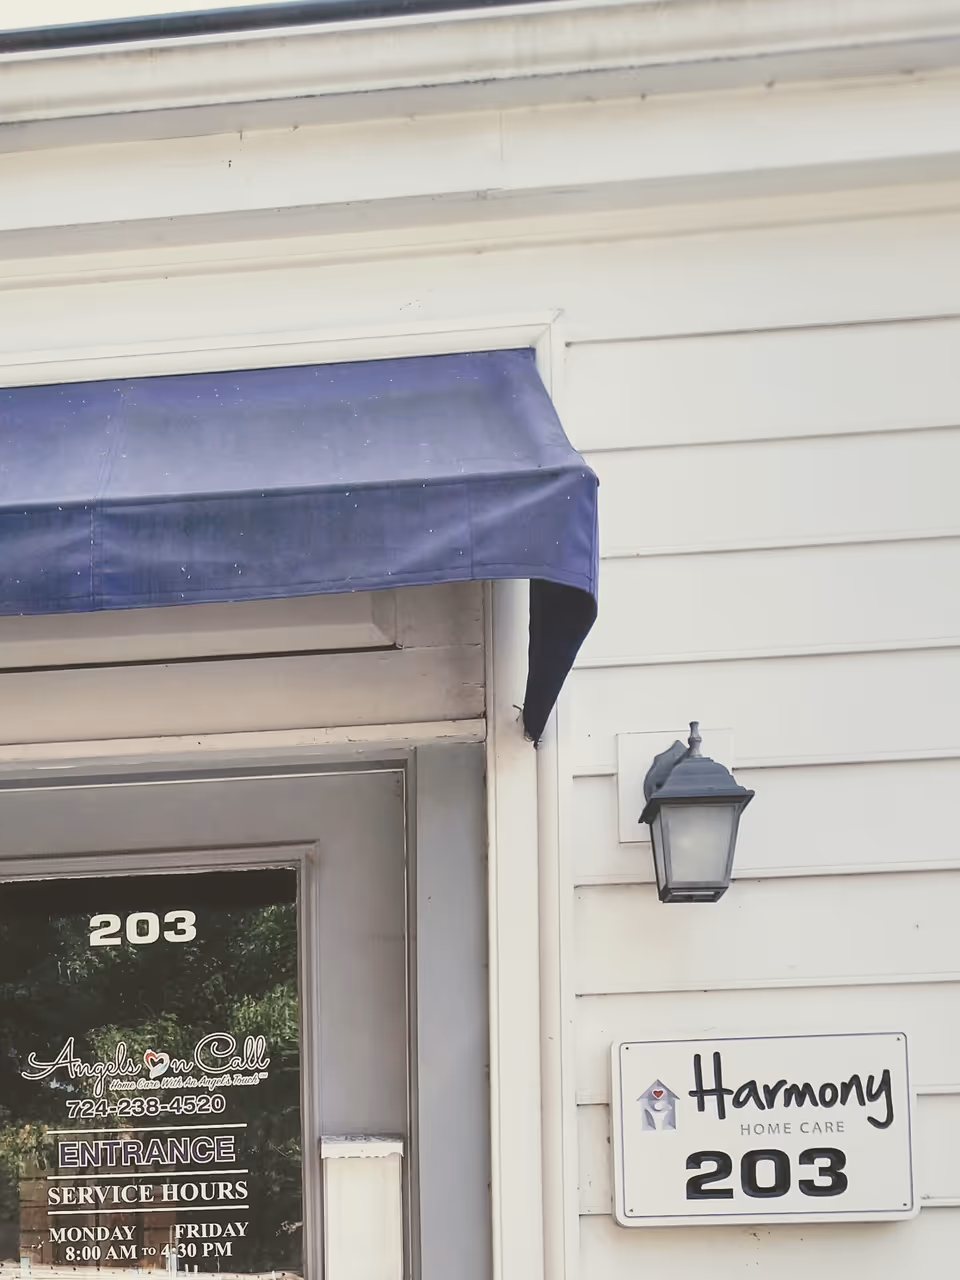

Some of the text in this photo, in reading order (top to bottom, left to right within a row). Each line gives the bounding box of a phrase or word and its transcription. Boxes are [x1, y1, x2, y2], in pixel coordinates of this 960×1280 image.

[89, 909, 197, 947] 203
[21, 1036, 141, 1098] Angels
[194, 1032, 271, 1074] Call
[109, 1078, 136, 1091] Home
[136, 1077, 160, 1090] Care
[161, 1076, 184, 1089] With
[232, 1072, 260, 1086] Touch
[688, 1050, 894, 1130] Harmony
[66, 1093, 226, 1119] 724-238-4520
[740, 1121, 845, 1136] HOME CARE
[58, 1135, 236, 1168] ENTRANCE
[685, 1146, 848, 1200] 203
[47, 1180, 249, 1206] SERVICE HOURS
[48, 1221, 249, 1243] MONDAY FRIDAY
[65, 1245, 101, 1261] 8:00
[105, 1244, 138, 1260] AM
[142, 1247, 156, 1256] TO
[202, 1242, 233, 1258] PM
